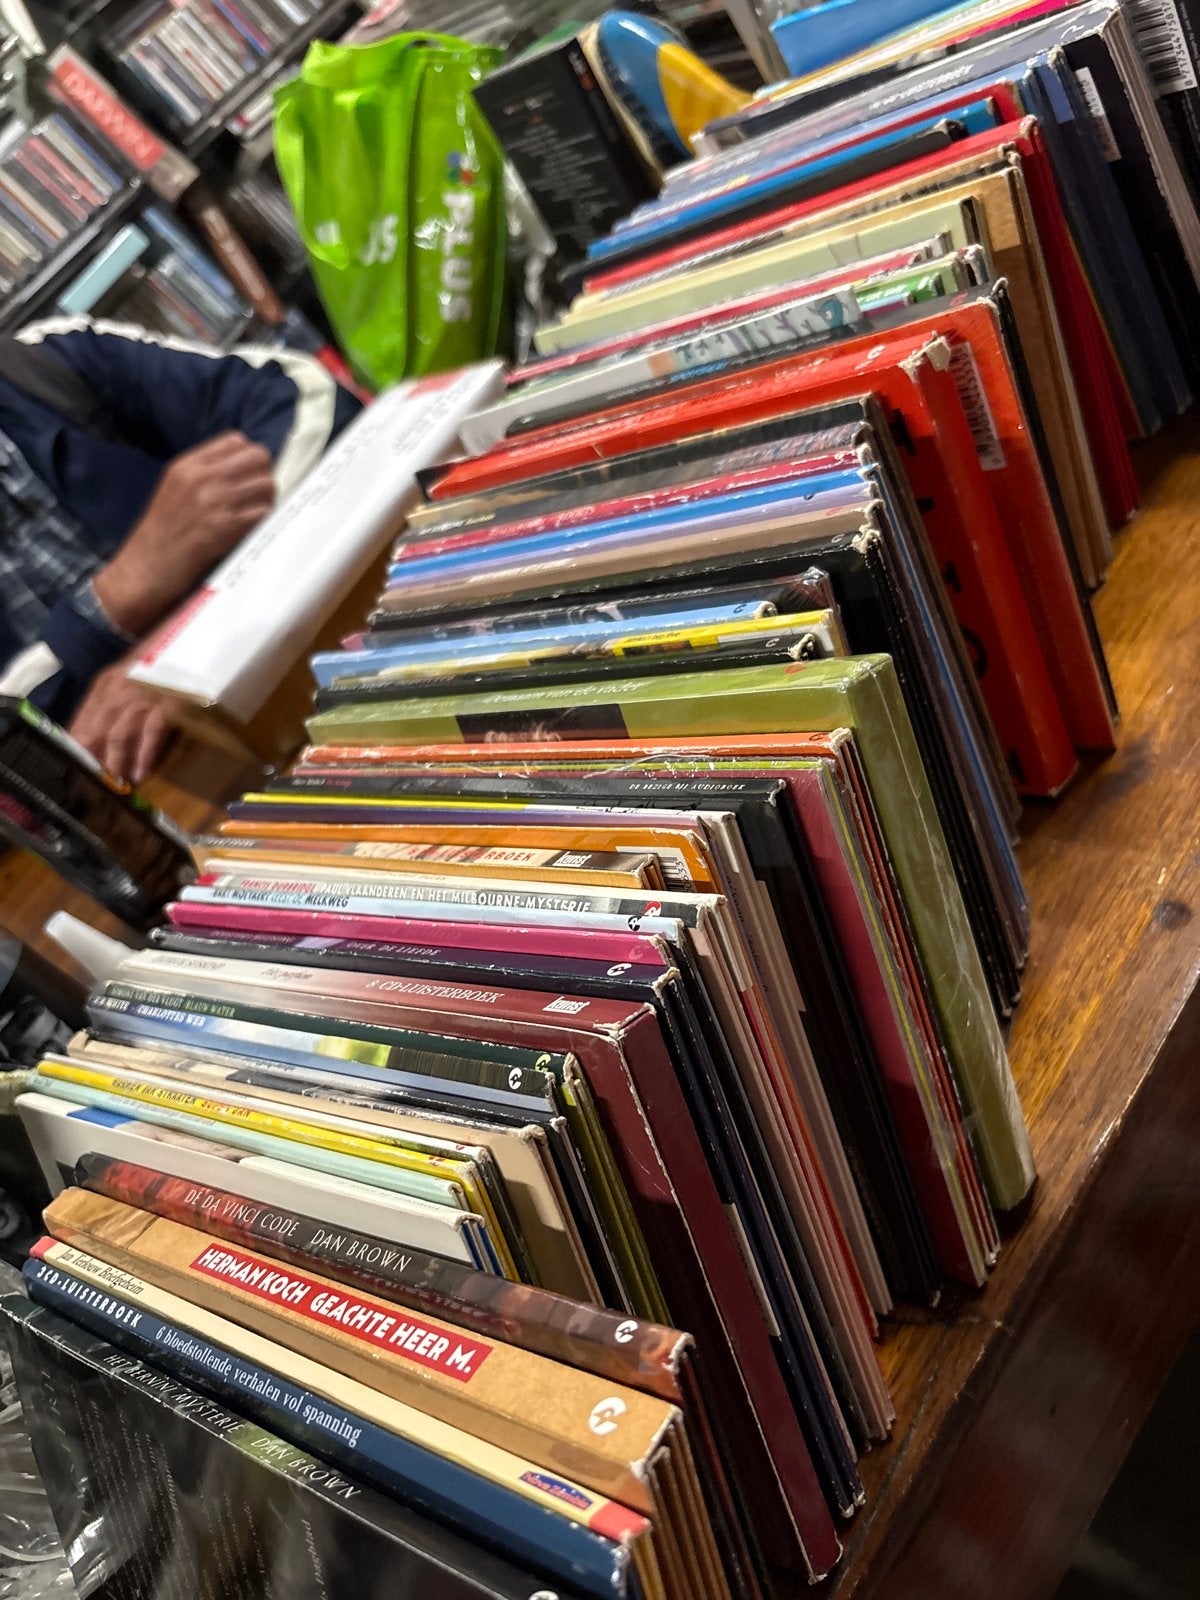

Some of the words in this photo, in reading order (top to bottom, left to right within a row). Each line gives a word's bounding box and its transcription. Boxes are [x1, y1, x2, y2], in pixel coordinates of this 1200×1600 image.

[304, 895, 350, 907] MELKWEG
[319, 882, 343, 895] PAUL
[346, 884, 407, 899] VLAANDEREN
[411, 888, 424, 900] EN
[428, 889, 448, 902] HET
[452, 890, 591, 913] MILBOURNE-MYSTERIE
[379, 944, 395, 952] DE
[396, 946, 441, 957] LIEFDE
[137, 1003, 185, 1023] CHARLOTTES
[186, 1014, 207, 1027] WEB
[209, 1003, 236, 1018] WATER
[380, 980, 506, 1004] CD-LUISTERBOEK
[543, 996, 591, 1015] kunst
[184, 1188, 203, 1206] DE
[201, 1194, 219, 1212] DA
[222, 1201, 261, 1224] VINCI
[260, 1213, 300, 1238] CODE
[311, 1229, 346, 1252] DAN
[346, 1240, 412, 1273] BROWN
[56, 1248, 75, 1264] Jan
[71, 1252, 104, 1278] Terlouw
[99, 1265, 145, 1295] Briefgeheim
[198, 1247, 267, 1287] HERMAN
[260, 1272, 312, 1304] KOCH
[309, 1292, 396, 1339] GEACHTE
[389, 1322, 450, 1361] HEER
[446, 1344, 478, 1374] M.
[155, 1325, 165, 1340] 6
[163, 1327, 232, 1376] bloedstollende
[233, 1367, 281, 1402] verhalen
[283, 1391, 304, 1413] vol
[302, 1404, 362, 1448] spanning
[103, 1354, 132, 1374] HET
[127, 1362, 179, 1393] BERNINI
[171, 1393, 246, 1434] MYSTERIE
[251, 1437, 293, 1460] DAN
[288, 1459, 363, 1500] BROWN
